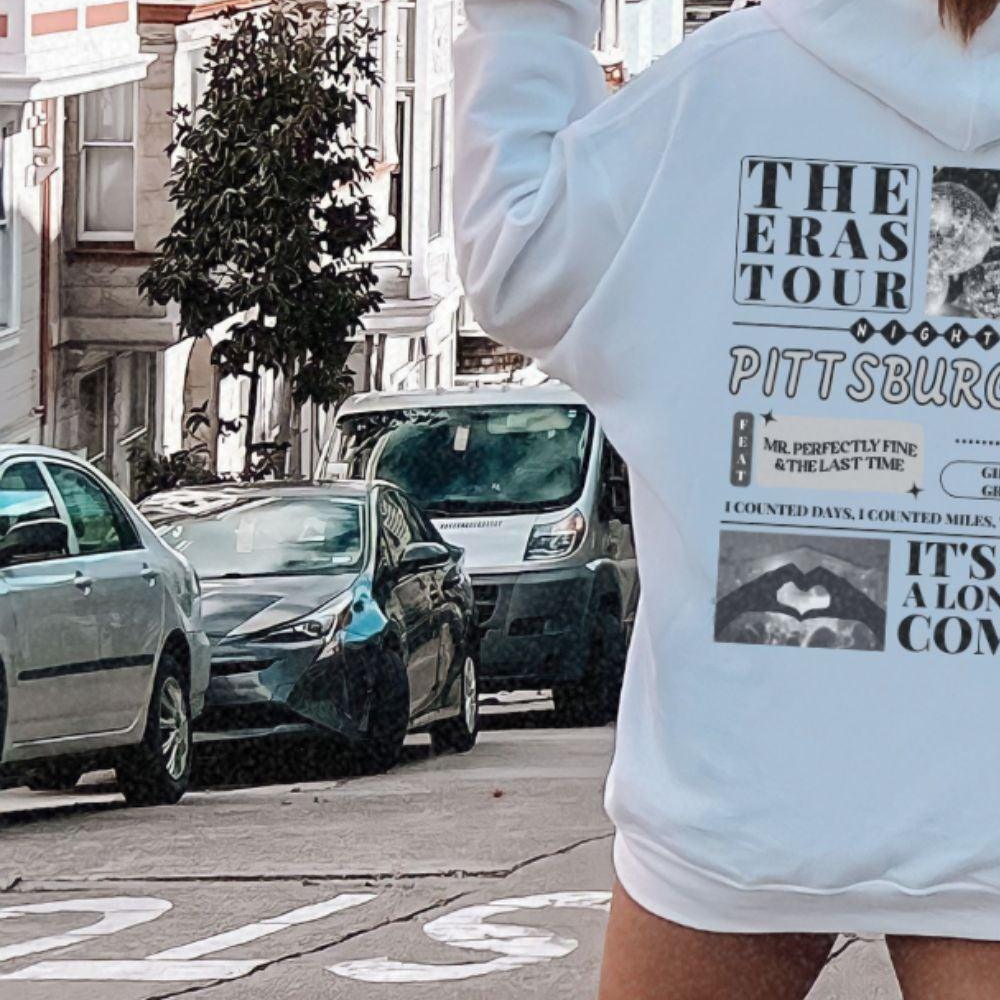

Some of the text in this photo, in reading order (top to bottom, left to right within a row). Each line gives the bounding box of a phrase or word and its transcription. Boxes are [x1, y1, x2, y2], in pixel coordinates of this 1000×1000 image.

[748, 159, 909, 217] THE
[742, 212, 909, 262] ERAS
[739, 263, 907, 310] TOUR
[855, 323, 993, 346] NIGHT
[736, 419, 748, 481] FEAT
[763, 437, 918, 457] MR. PERFECTLY FINE
[786, 458, 817, 473] THE
[819, 456, 863, 473] LAST
[865, 456, 904, 472] TIME
[724, 501, 730, 513] I
[733, 502, 808, 517] COUNTED
[812, 505, 855, 521] DAYS,
[858, 508, 864, 520] I
[867, 509, 943, 525] COUNTED
[945, 513, 996, 529] MILES,
[906, 540, 997, 581] IT'S
[902, 581, 928, 609] A
